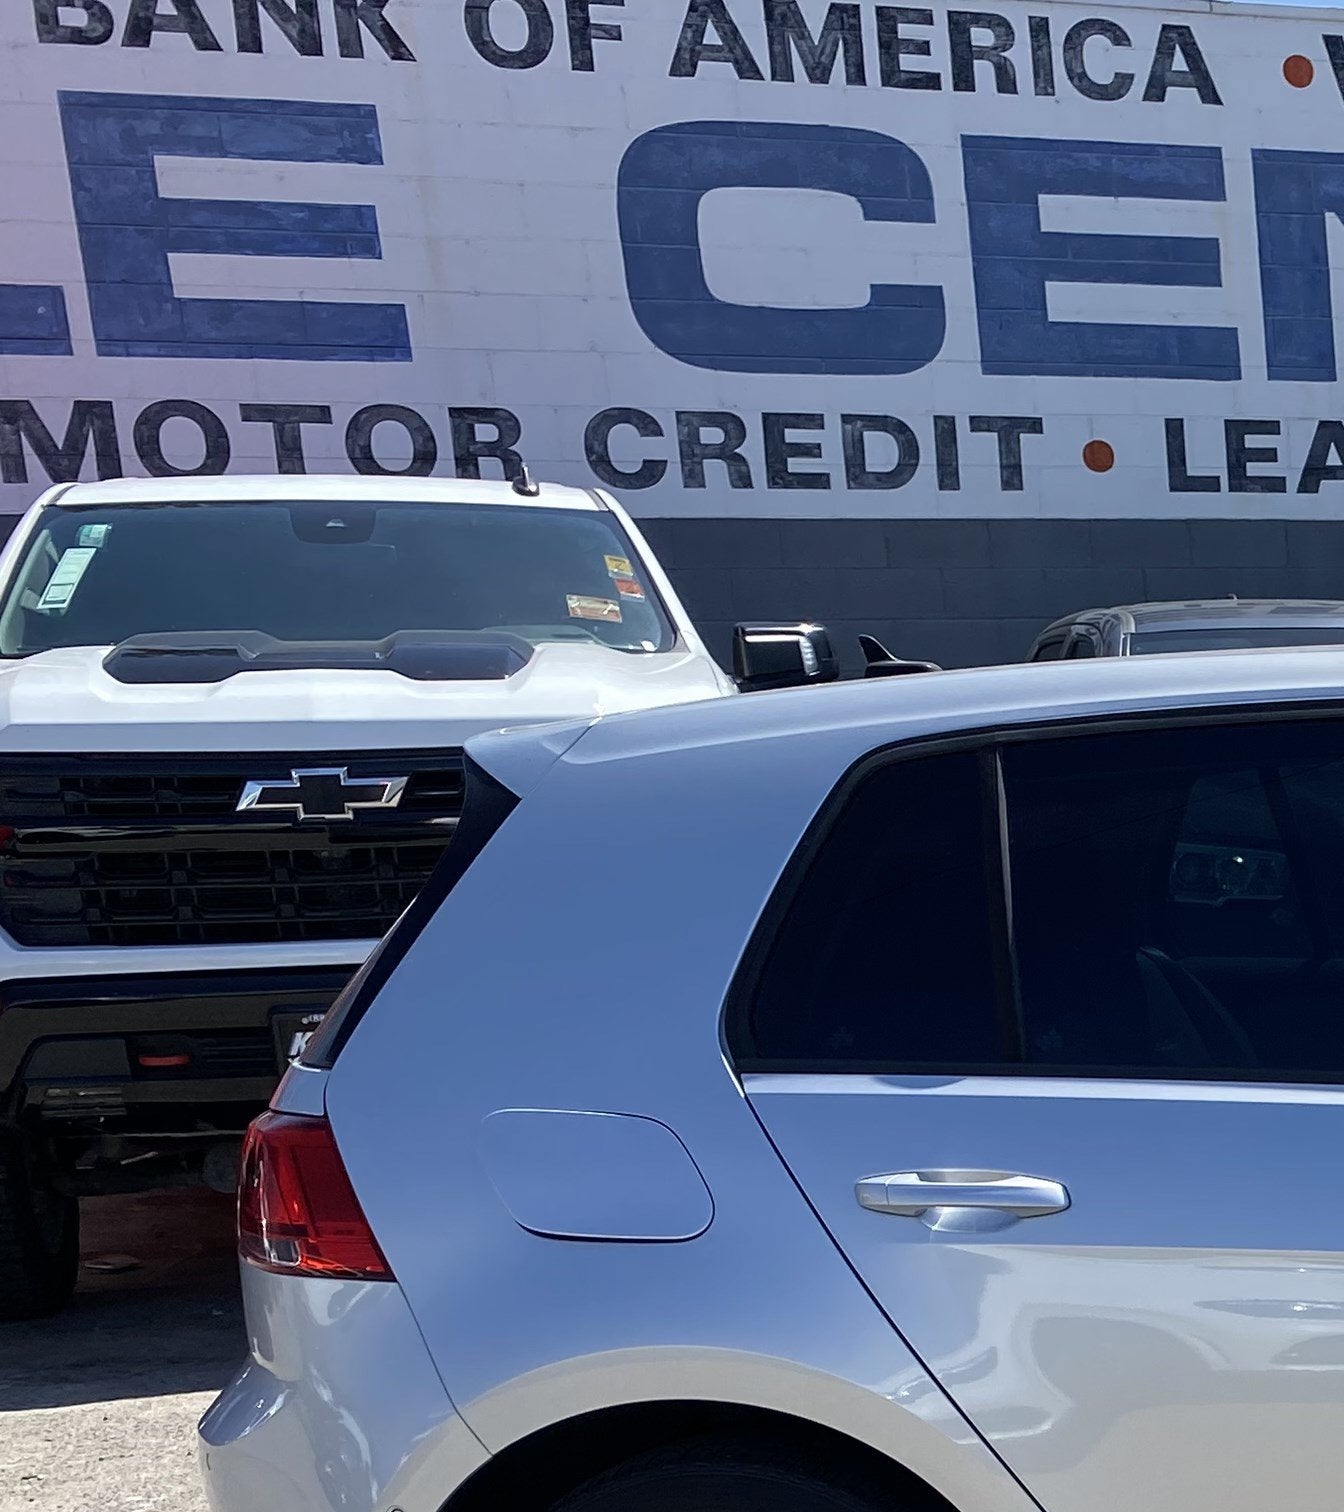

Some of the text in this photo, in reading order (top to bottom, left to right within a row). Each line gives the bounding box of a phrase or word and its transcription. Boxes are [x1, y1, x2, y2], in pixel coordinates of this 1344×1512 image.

[35, 0, 417, 61] BANK
[464, 0, 625, 70] OF
[667, 0, 1224, 107] AMERICA
[0, 399, 524, 490] MOTOR
[584, 406, 1043, 492] CREDIT
